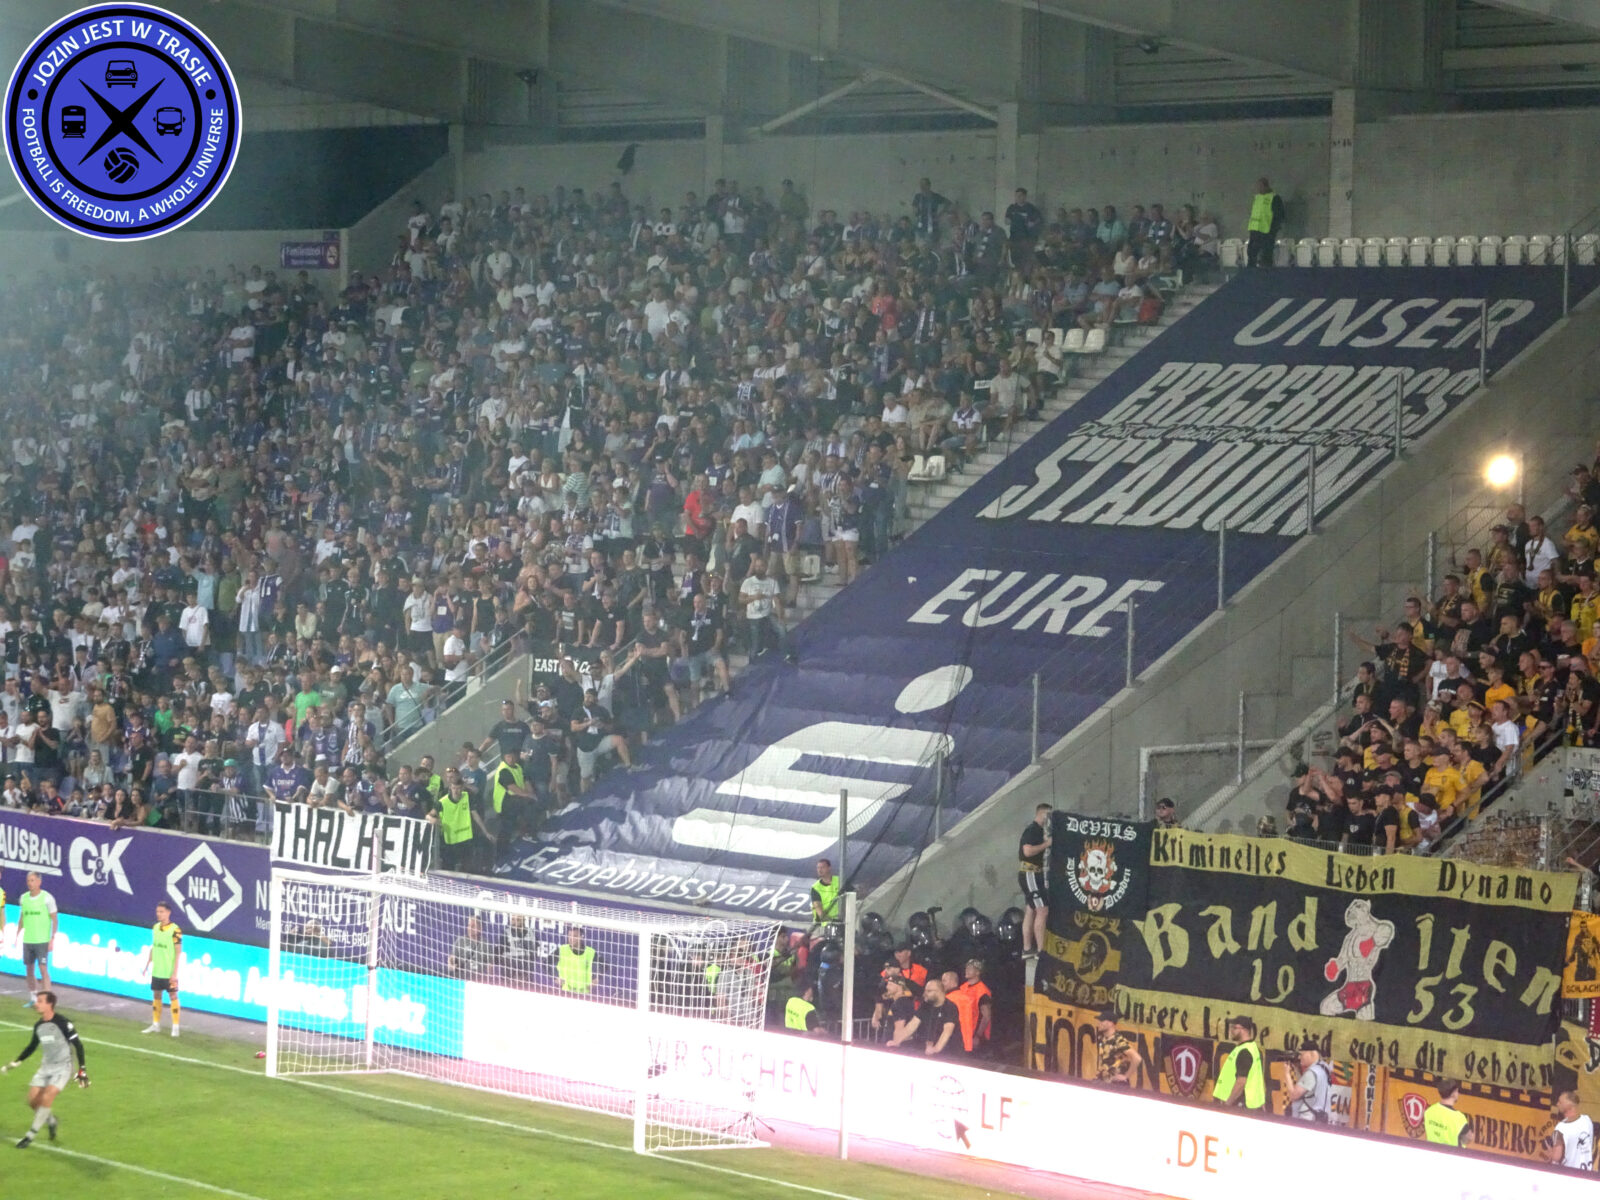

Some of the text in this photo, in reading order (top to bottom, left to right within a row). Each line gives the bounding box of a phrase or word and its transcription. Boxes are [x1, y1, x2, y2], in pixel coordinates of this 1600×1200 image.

[1233, 298, 1535, 350] UNSER
[976, 436, 1397, 536] STADION
[906, 567, 1166, 638] EURE
[275, 802, 434, 875] THALHEIM
[1066, 816, 1137, 842] DEVILS
[188, 875, 221, 903] NHA
[1153, 830, 1553, 905] Kriminelles Leben Dynamo
[380, 898, 417, 936] AUE
[1407, 971, 1479, 1031] 53
[701, 1043, 820, 1098] SUCHEN
